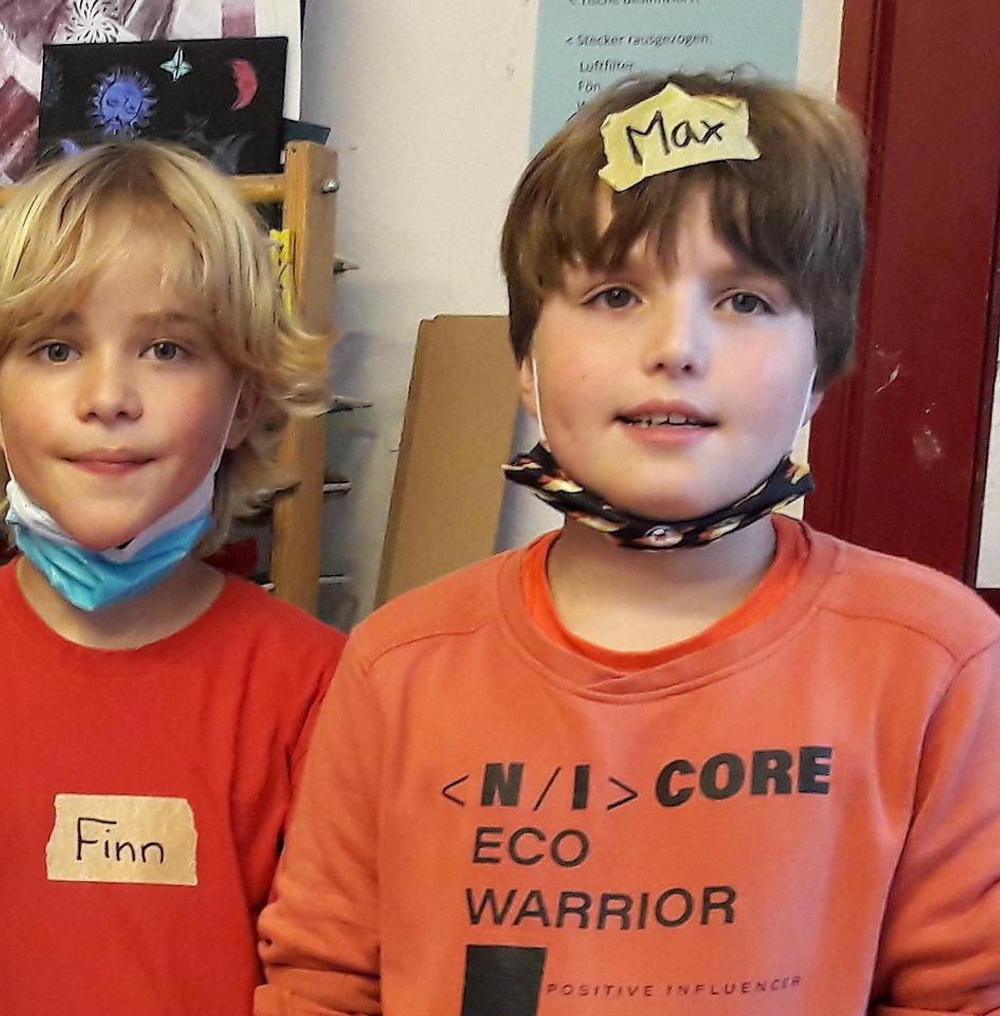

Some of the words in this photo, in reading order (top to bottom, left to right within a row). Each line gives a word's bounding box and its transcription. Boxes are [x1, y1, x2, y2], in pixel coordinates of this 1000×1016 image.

[625, 110, 725, 166] Max
[655, 746, 833, 808] CORE
[76, 816, 165, 864] Finn
[472, 826, 591, 868] ECO
[465, 885, 738, 931] WARRIOR
[547, 983, 654, 997] POSITIVE
[665, 976, 802, 996] INFLUENCER
